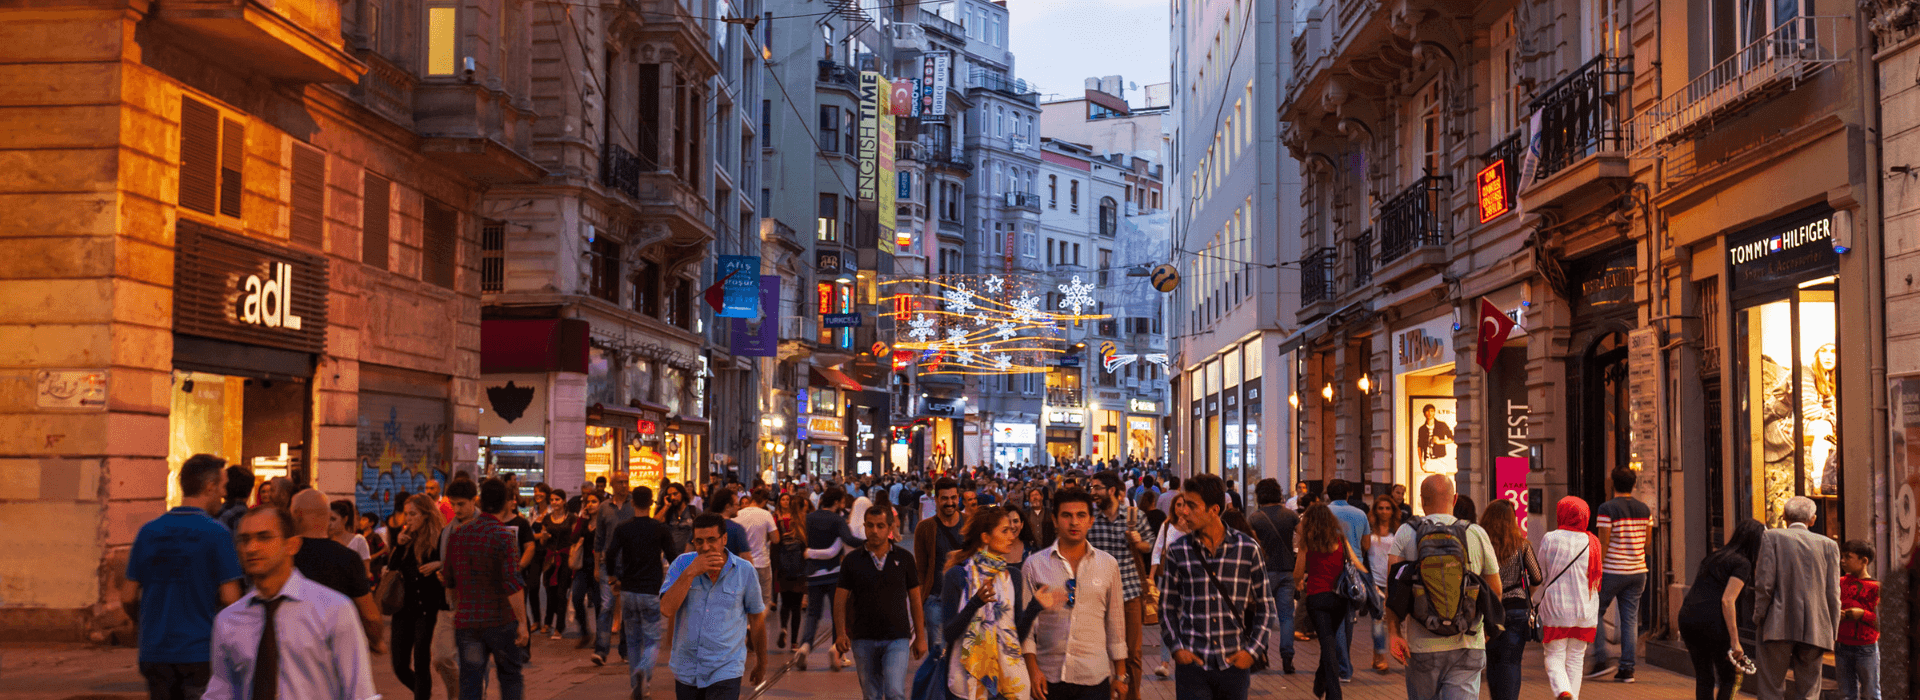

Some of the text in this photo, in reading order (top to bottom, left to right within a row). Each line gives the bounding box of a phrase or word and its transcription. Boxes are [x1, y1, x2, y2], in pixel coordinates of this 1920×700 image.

[938, 58, 946, 82] KURSU
[859, 75, 877, 200] ENGLISH TIME
[1730, 237, 1769, 265] TOMMY
[1782, 218, 1831, 250] HILFIGER
[244, 262, 301, 330] adL
[825, 316, 860, 325] TURKCELL
